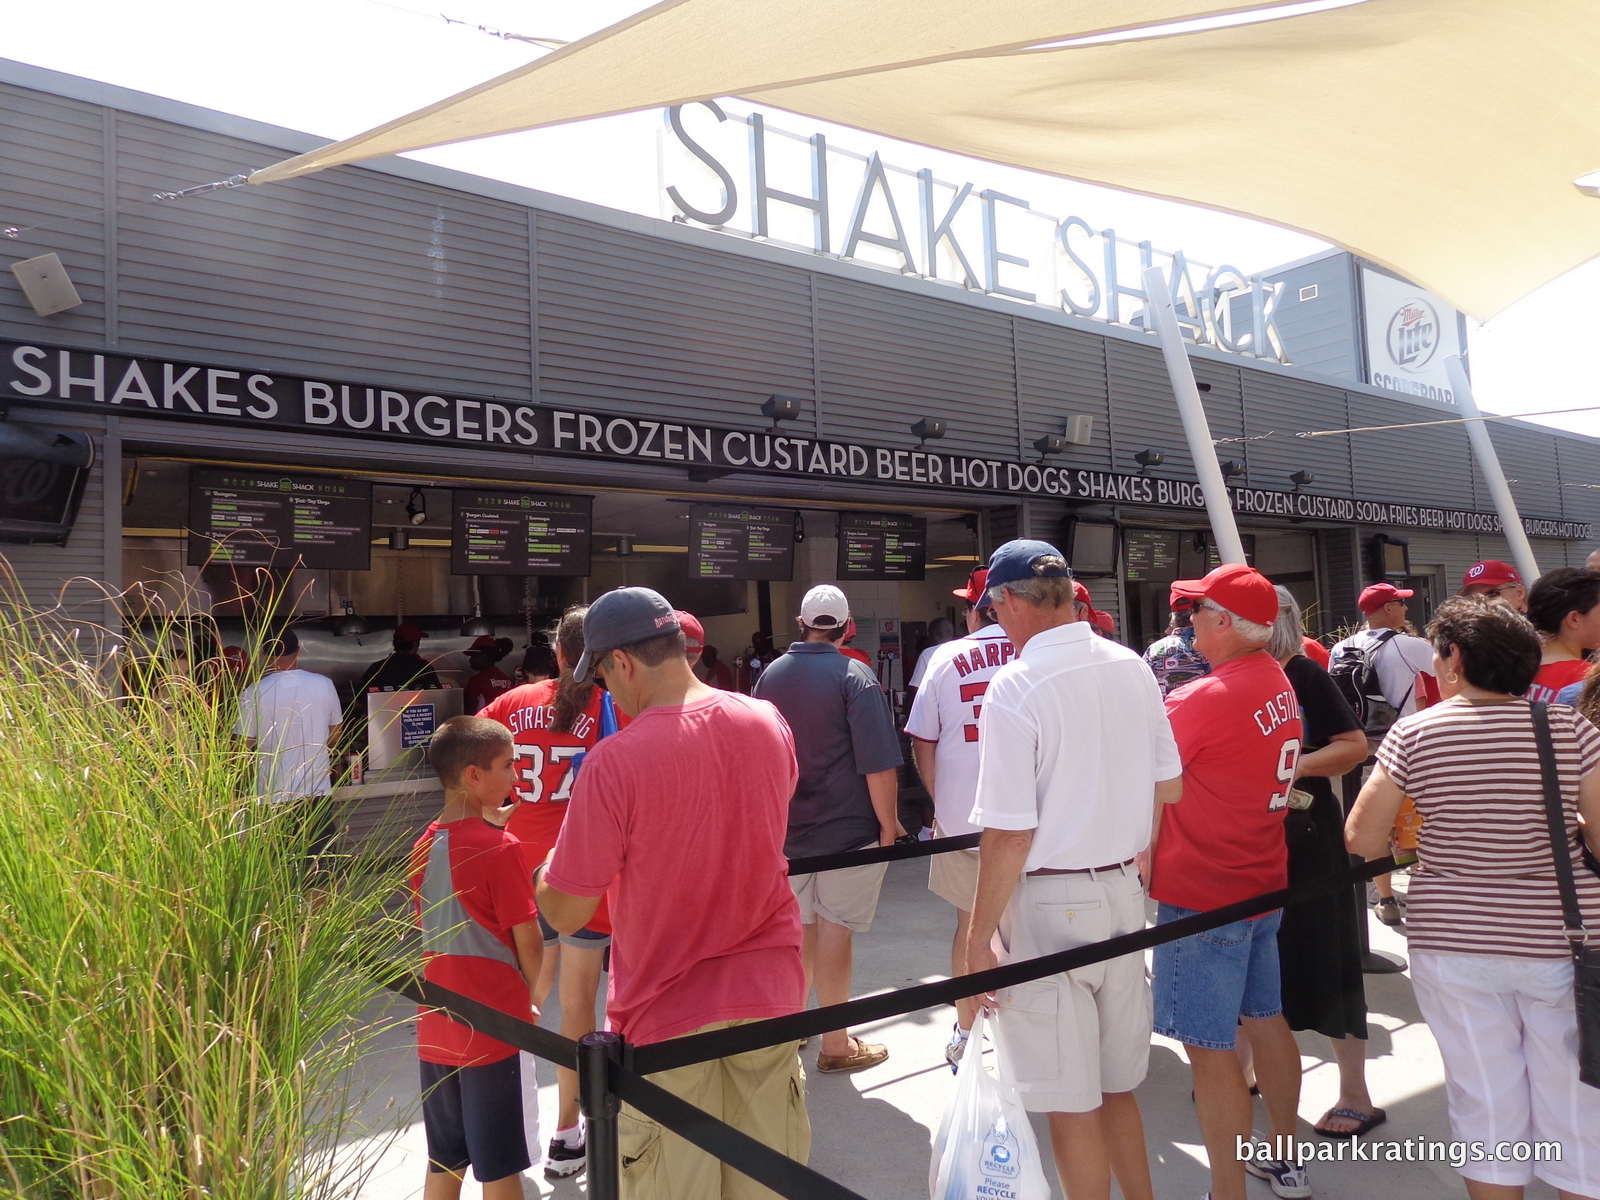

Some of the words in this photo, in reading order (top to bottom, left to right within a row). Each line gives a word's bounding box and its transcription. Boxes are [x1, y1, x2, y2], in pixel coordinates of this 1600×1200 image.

[665, 98, 1037, 303] SHAKE
[1056, 215, 1290, 366] SHACK
[1399, 306, 1426, 324] Miller
[1397, 320, 1433, 366] Lite
[1374, 372, 1458, 405] SCOREBOAR
[9, 345, 279, 420] SHAKES
[303, 381, 539, 446] BURGERS
[553, 411, 713, 462] FROZEN
[722, 431, 868, 477] CUSTARD
[876, 449, 943, 484] BEER
[950, 456, 1002, 489] HOT
[1007, 463, 1071, 496] DOGS
[1077, 470, 1153, 502] SHAKES
[1236, 488, 1294, 514] FROZEN
[1297, 495, 1354, 520] CUSTARD
[1356, 501, 1389, 523] SODA
[1389, 504, 1418, 526] FRIES
[1419, 508, 1445, 528] BEER
[1446, 511, 1466, 530] HOT
[1467, 513, 1493, 532] DOGS
[1525, 518, 1558, 537] BURGERS
[1559, 521, 1573, 538] HOT
[1574, 523, 1594, 539] DOGS
[256, 480, 279, 489] SHAKE
[291, 483, 315, 491] SHACK
[952, 642, 1020, 678] HARP
[508, 705, 595, 740] STRASRG
[1253, 690, 1301, 738] CASTIL
[513, 743, 587, 803] 37
[1267, 738, 1301, 813] 9
[984, 1160, 1015, 1172] RECYCLE
[984, 1177, 1010, 1189] Please
[976, 1185, 1017, 1199] RECYCLE
